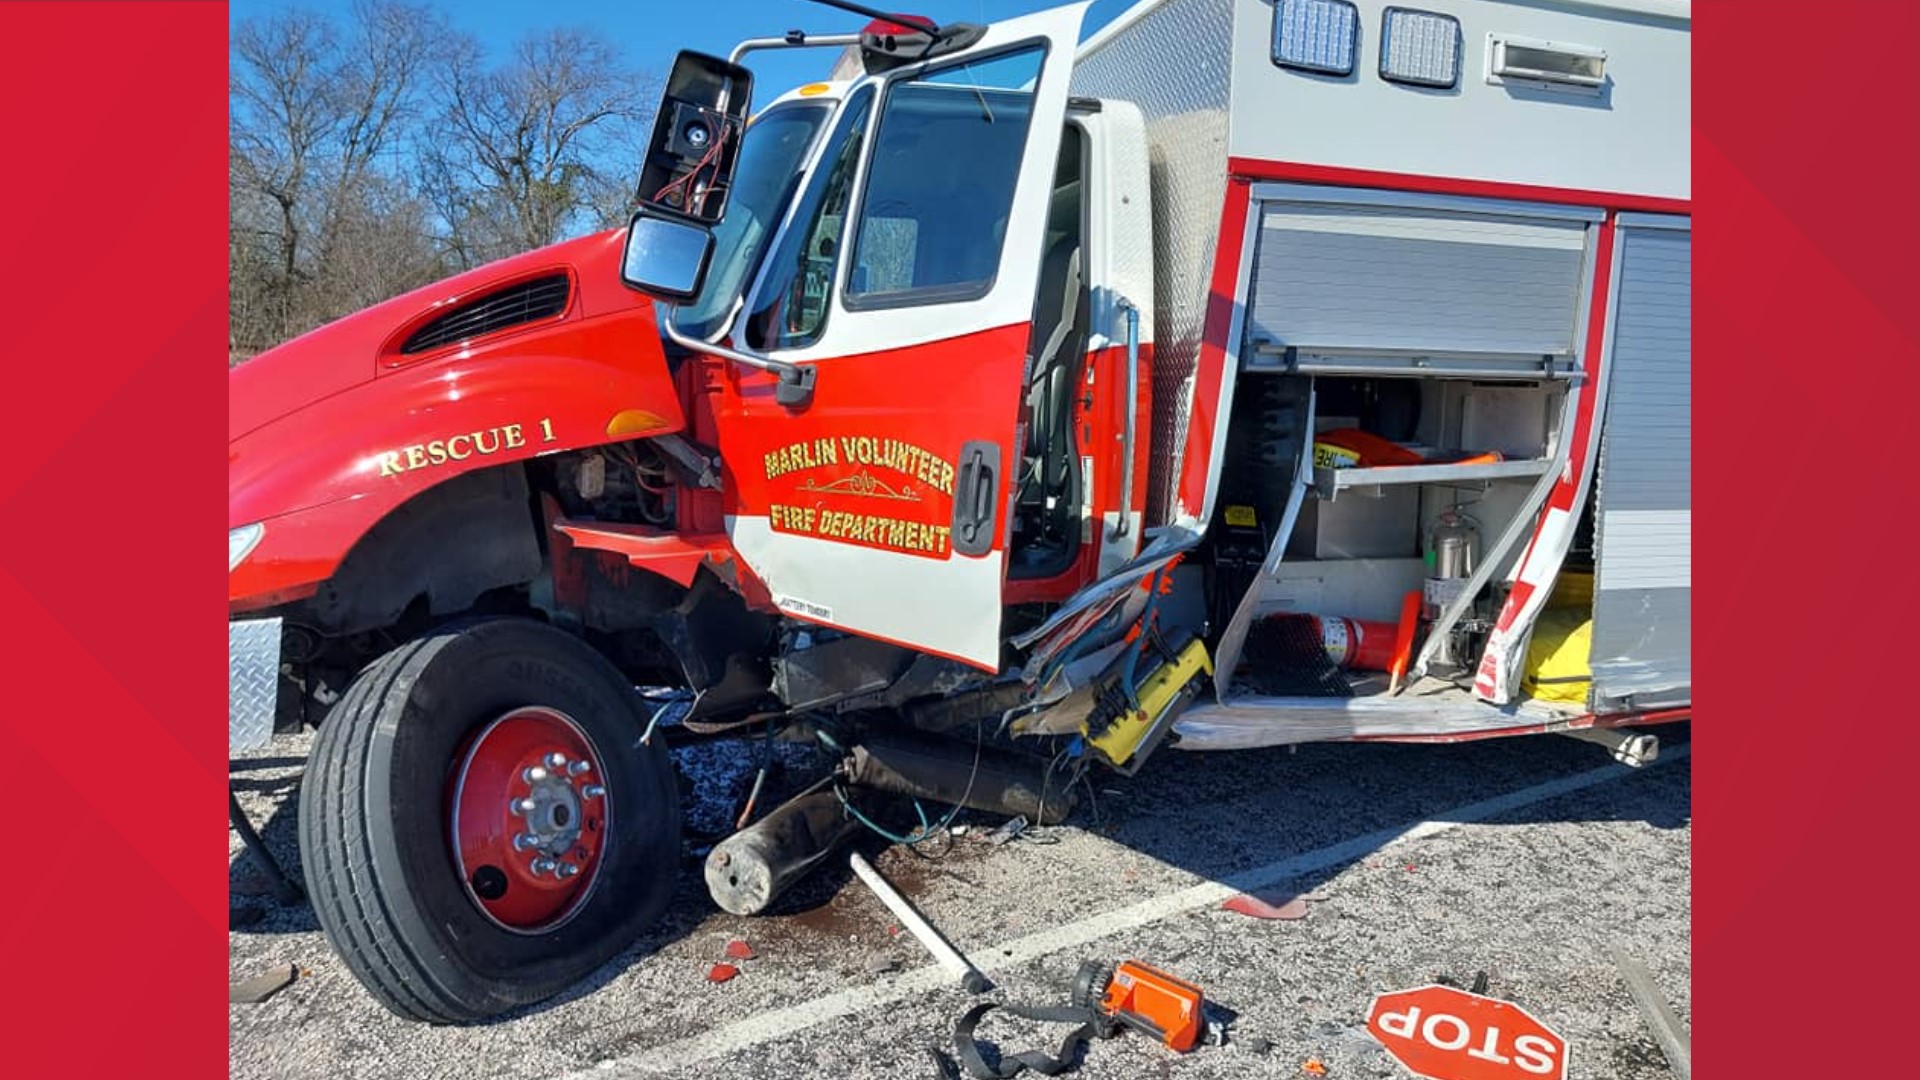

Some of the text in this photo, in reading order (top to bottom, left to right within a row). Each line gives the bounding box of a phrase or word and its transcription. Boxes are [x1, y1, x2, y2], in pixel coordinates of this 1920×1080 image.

[378, 417, 557, 477] RESCUE 1
[764, 436, 955, 495] MARLIN VOLUNTEER
[770, 504, 951, 553] FIRE DEPARTMENT
[1377, 1006, 1557, 1074] STOP
